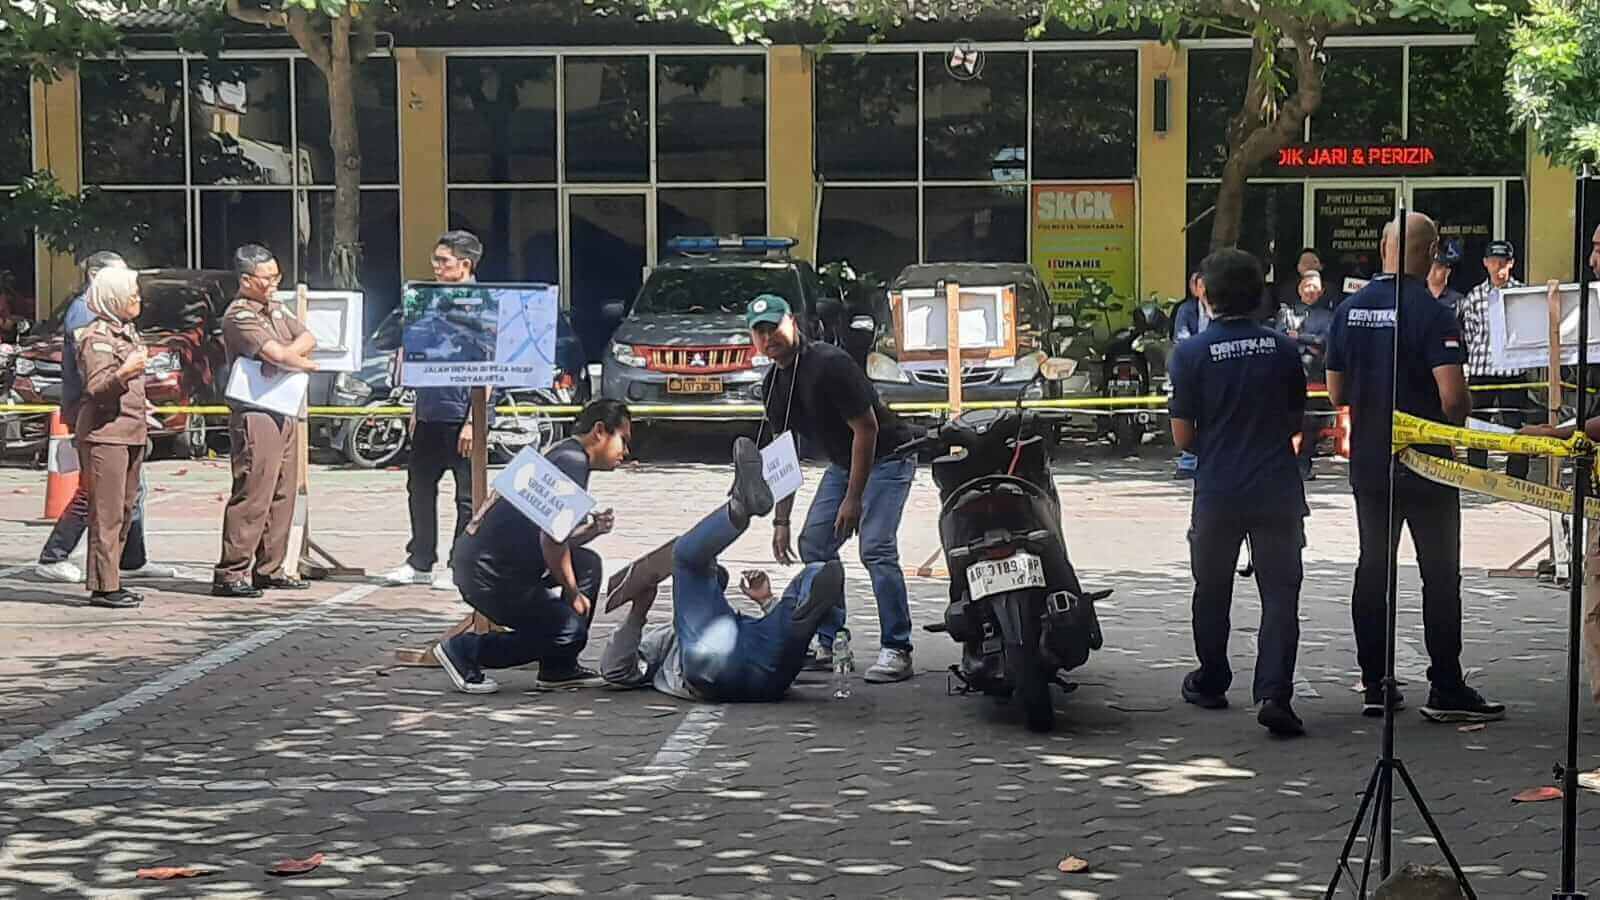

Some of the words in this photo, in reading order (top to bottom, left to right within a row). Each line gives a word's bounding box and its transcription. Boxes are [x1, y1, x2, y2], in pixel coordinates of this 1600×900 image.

[1308, 148, 1347, 165] JARI
[1352, 149, 1365, 165] &
[1038, 191, 1114, 220] SKCK
[1359, 229, 1379, 239] JARI
